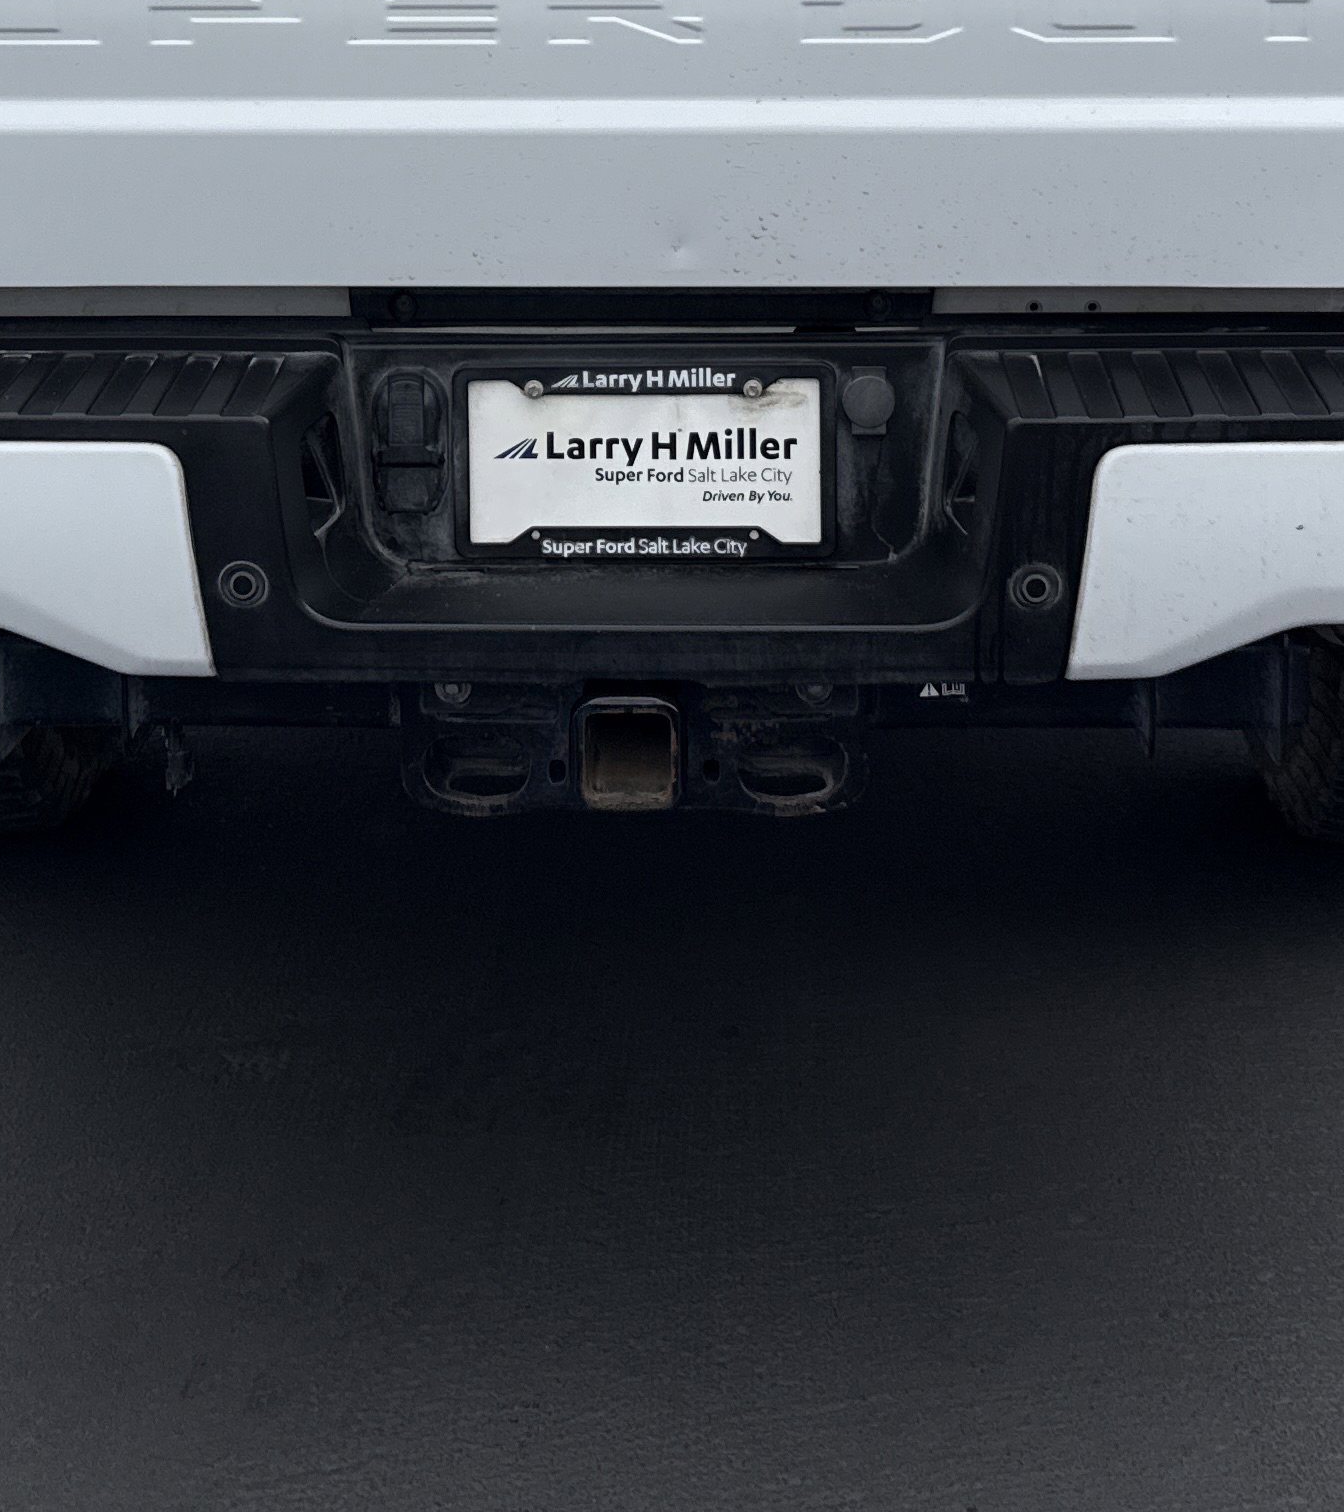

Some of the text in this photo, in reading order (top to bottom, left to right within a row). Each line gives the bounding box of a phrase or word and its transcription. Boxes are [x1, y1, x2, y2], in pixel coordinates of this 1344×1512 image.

[582, 367, 736, 392] Larry H Miller
[546, 427, 798, 466] Larry H Miller
[595, 465, 793, 486] Super Ford Salt Lake City
[702, 489, 745, 502] Driven
[749, 490, 765, 504] By
[542, 536, 748, 558] Super Ford Salt Lake City
